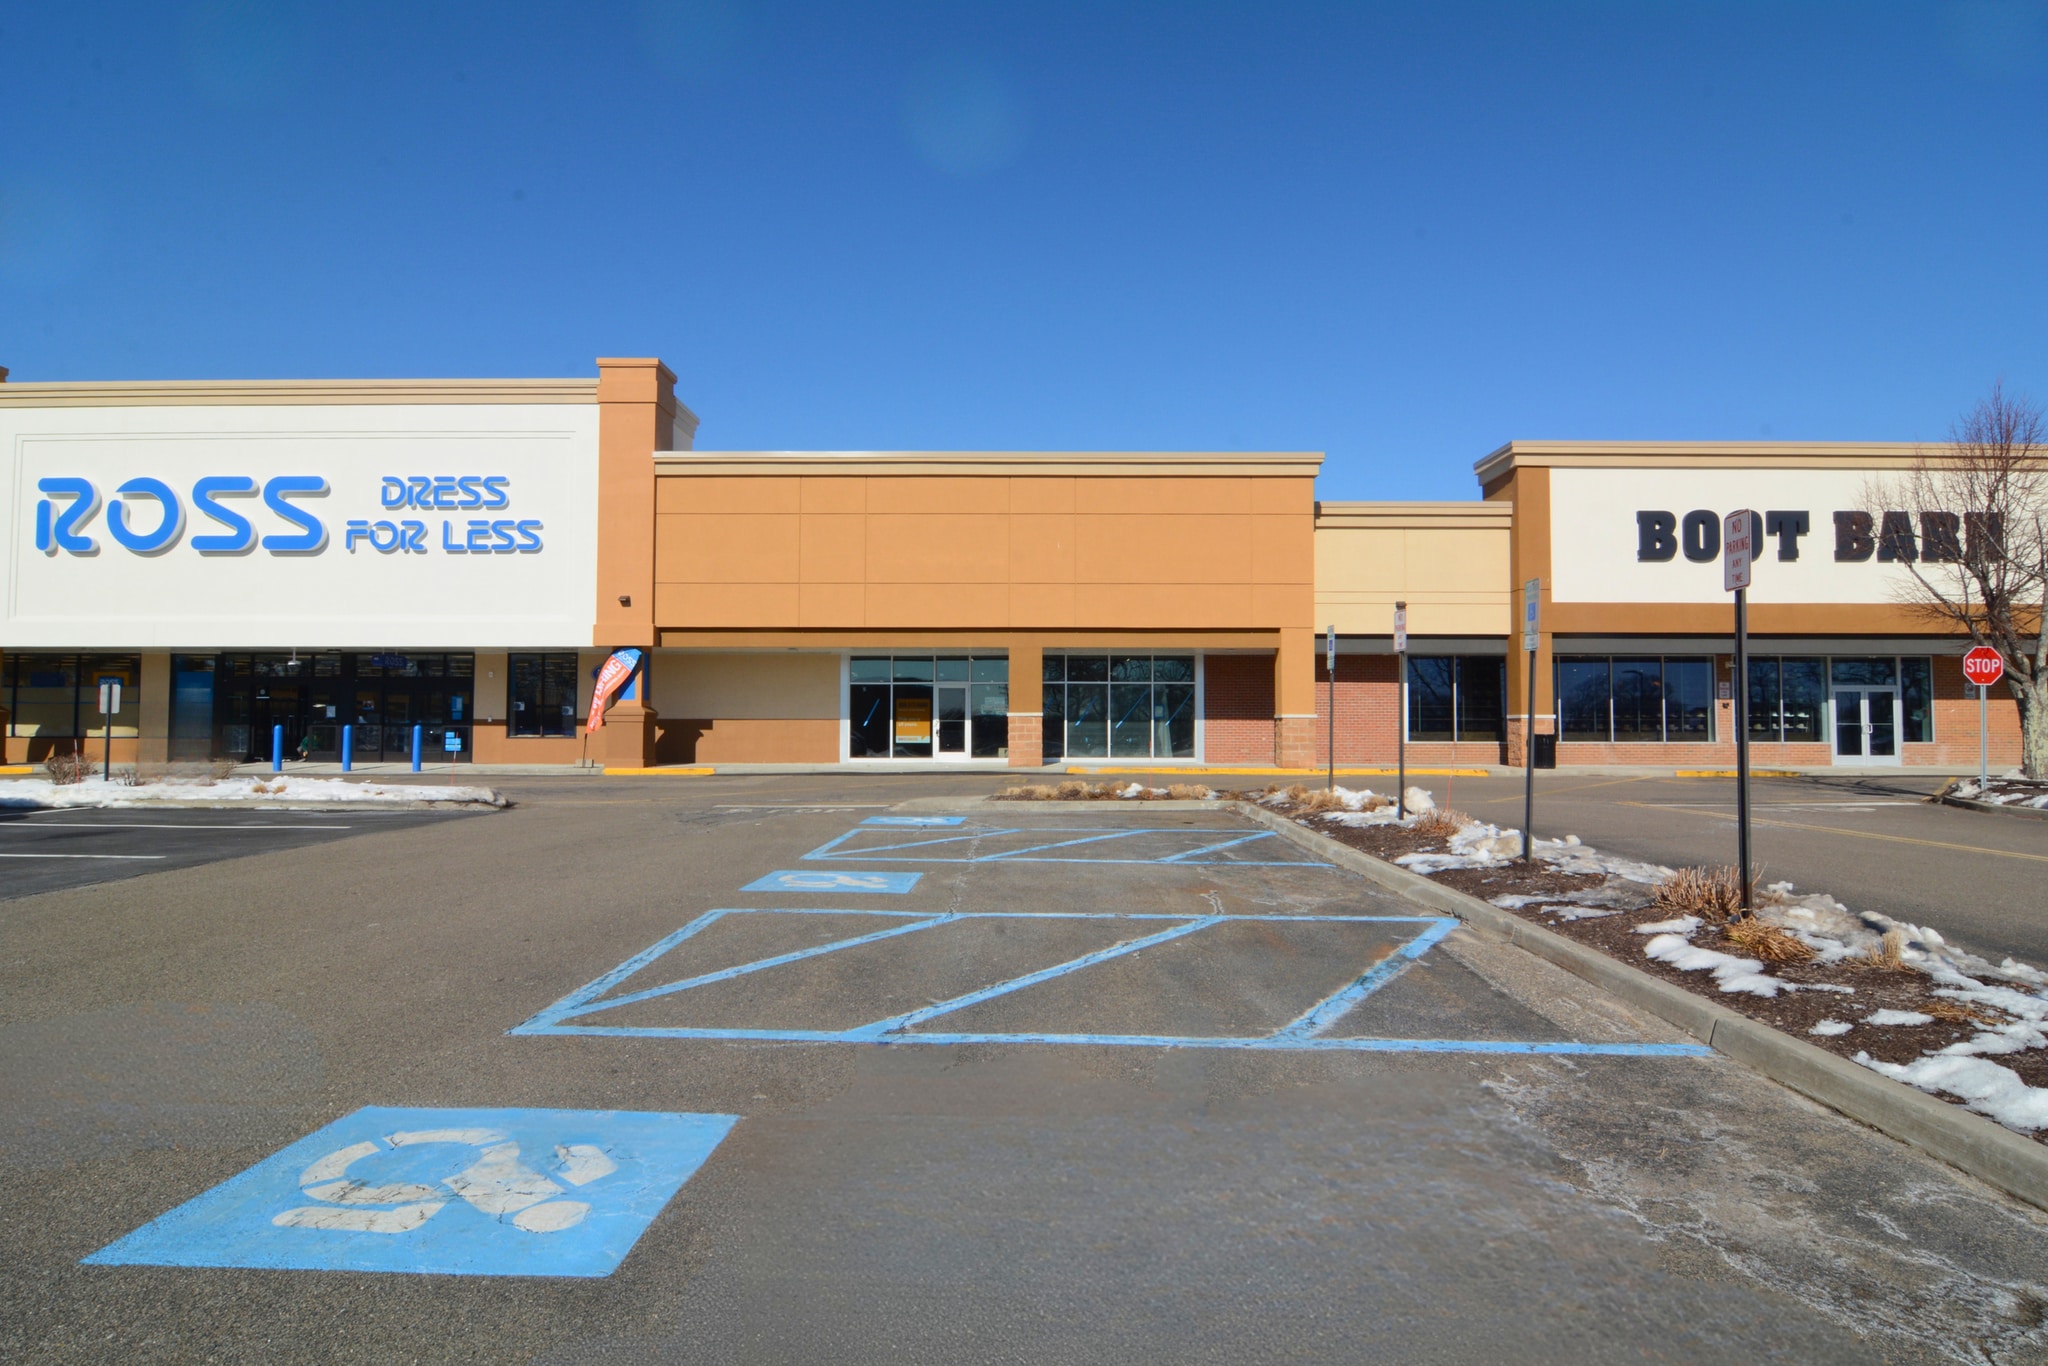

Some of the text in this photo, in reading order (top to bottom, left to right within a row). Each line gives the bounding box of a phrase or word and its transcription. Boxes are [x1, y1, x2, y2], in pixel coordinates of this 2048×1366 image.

[381, 475, 509, 508] DRESS
[36, 476, 330, 554] ROSS
[1731, 518, 1742, 534] NO
[345, 520, 542, 553] FOR LESS
[1726, 536, 1748, 556] PARKING
[1833, 511, 2005, 563] BARN
[1732, 558, 1742, 568] ANY
[1731, 572, 1743, 583] TIME
[1966, 658, 2000, 673] STOP
